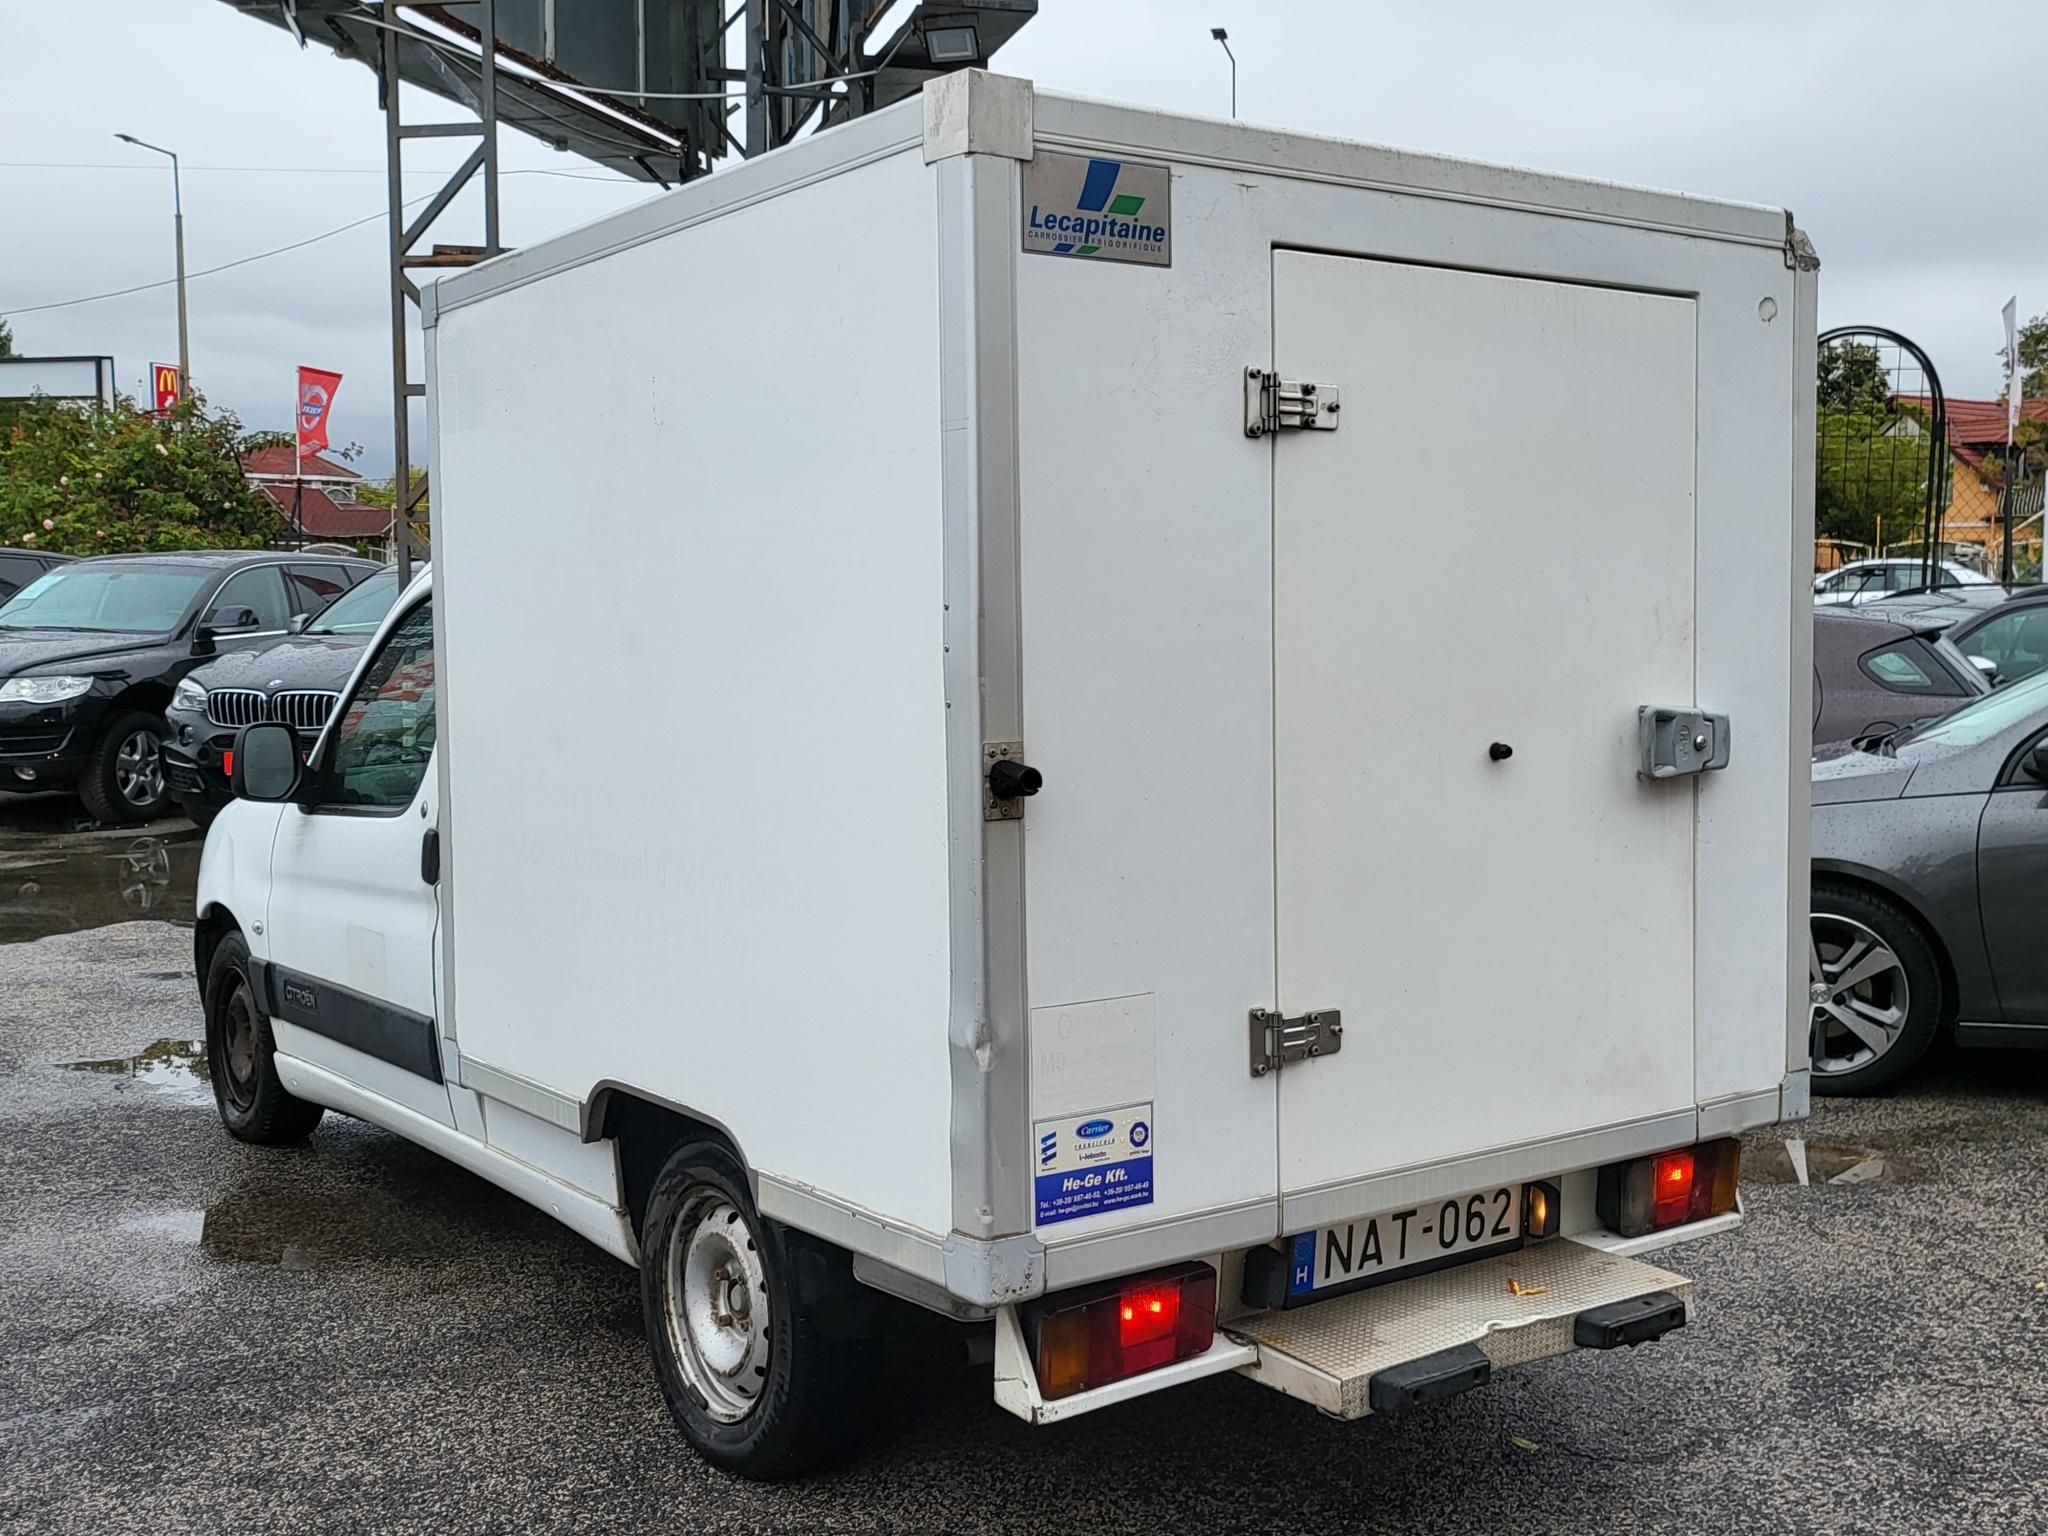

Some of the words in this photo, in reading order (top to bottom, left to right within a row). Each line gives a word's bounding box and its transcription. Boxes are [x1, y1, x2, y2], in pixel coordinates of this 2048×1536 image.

[1029, 205, 1165, 244] Lecapitaine
[1028, 230, 1083, 244] CARROSSIER
[1091, 238, 1162, 253] FRIGORIFIQUE
[1081, 1124, 1110, 1136] Carrier
[1062, 1173, 1102, 1192] He-Ge
[1105, 1168, 1128, 1184] Kft.
[1324, 1188, 1512, 1280] NAT-062
[1295, 1264, 1308, 1285] H
